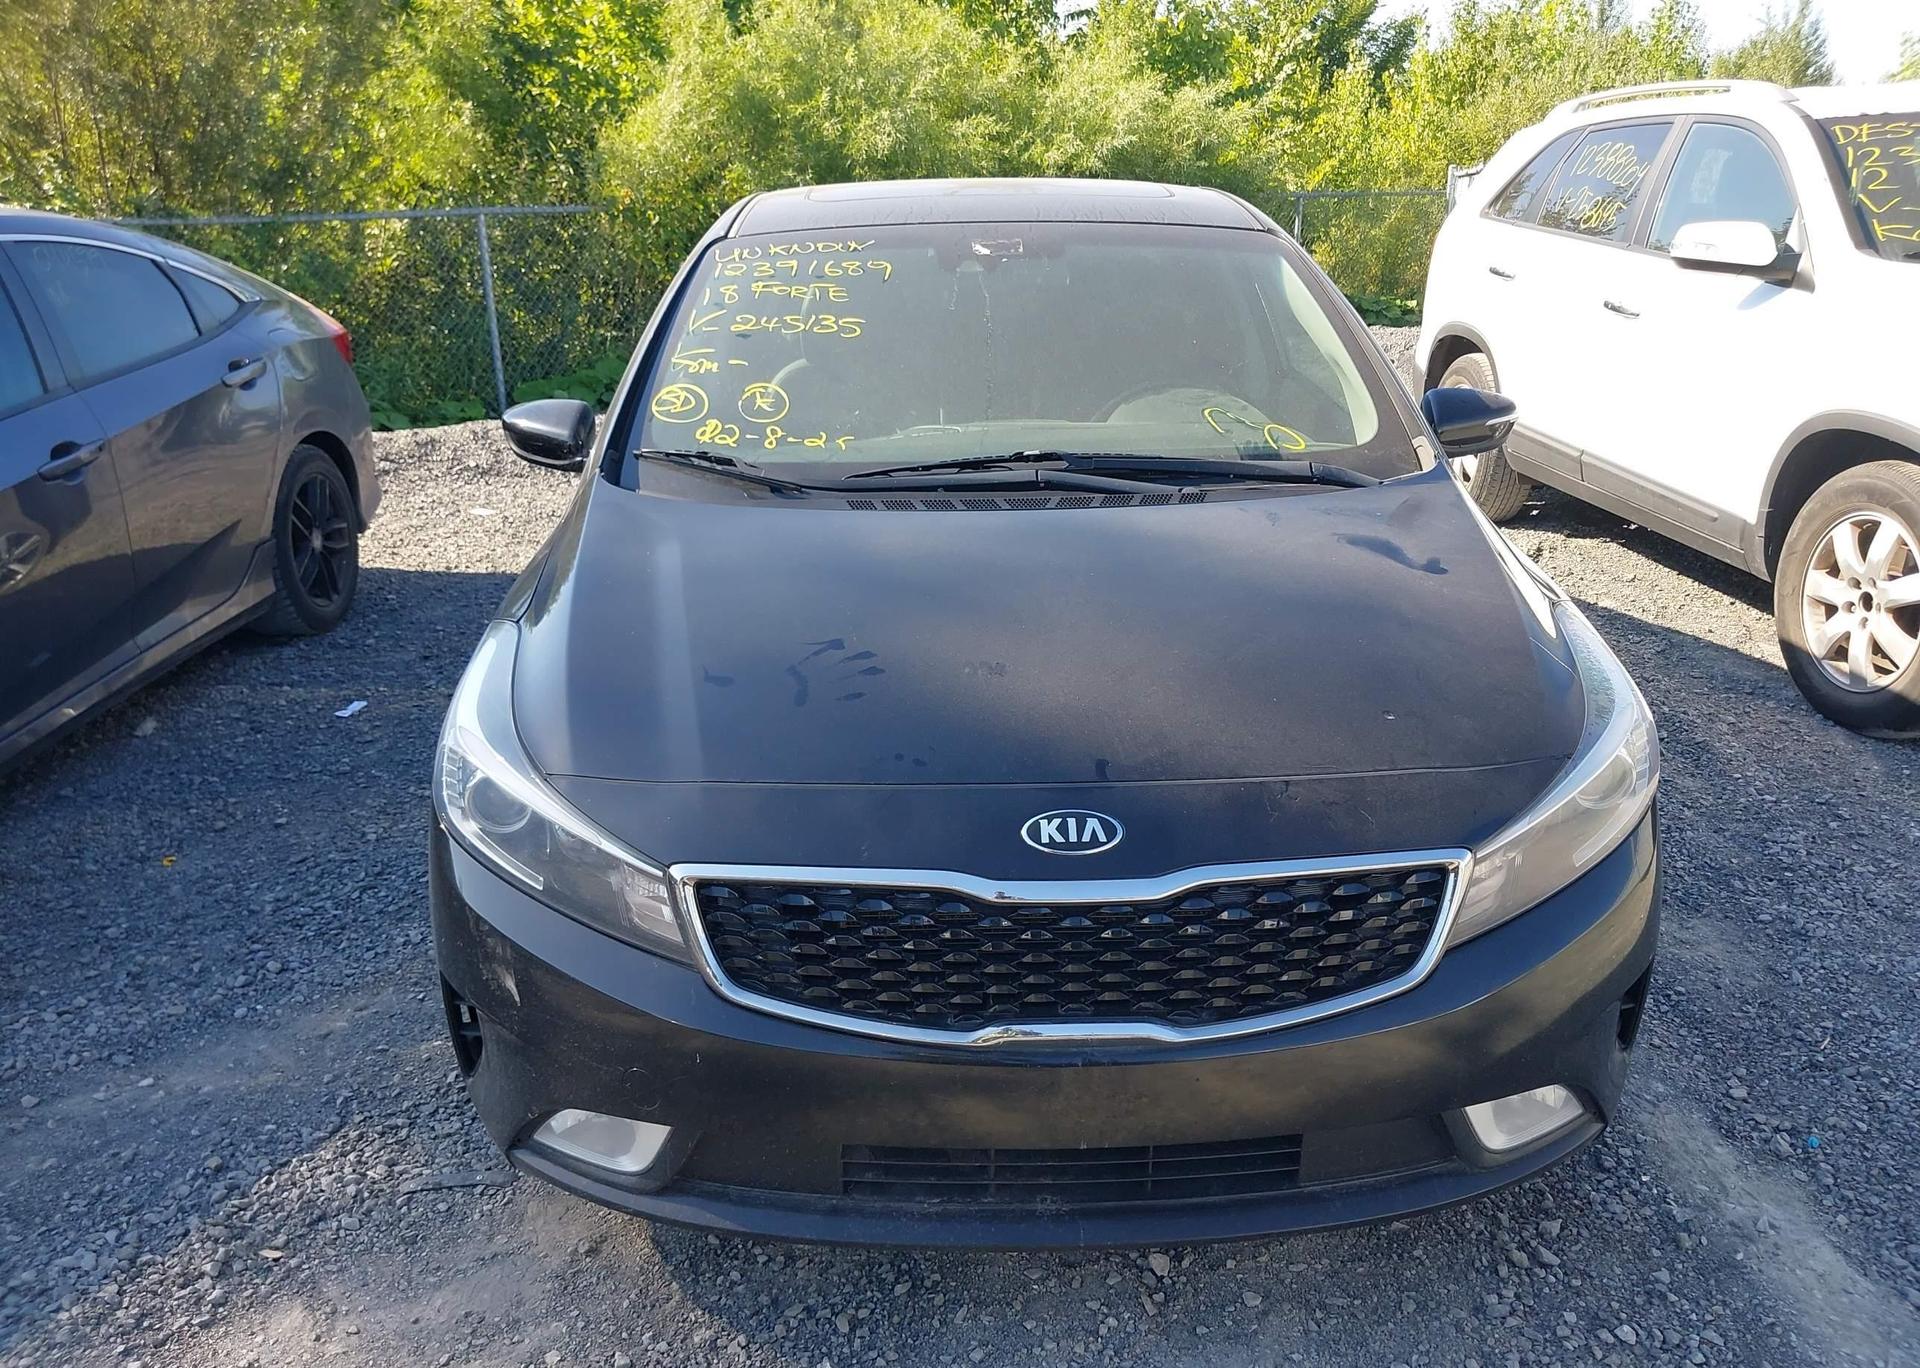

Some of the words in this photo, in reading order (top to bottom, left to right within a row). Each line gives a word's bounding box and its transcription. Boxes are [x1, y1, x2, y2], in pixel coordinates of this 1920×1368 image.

[1850, 167, 1902, 190] 12
[714, 259, 893, 281] 12391689
[702, 286, 740, 306] 18
[751, 281, 851, 303] FORTE
[1038, 817, 1108, 844] KIA
